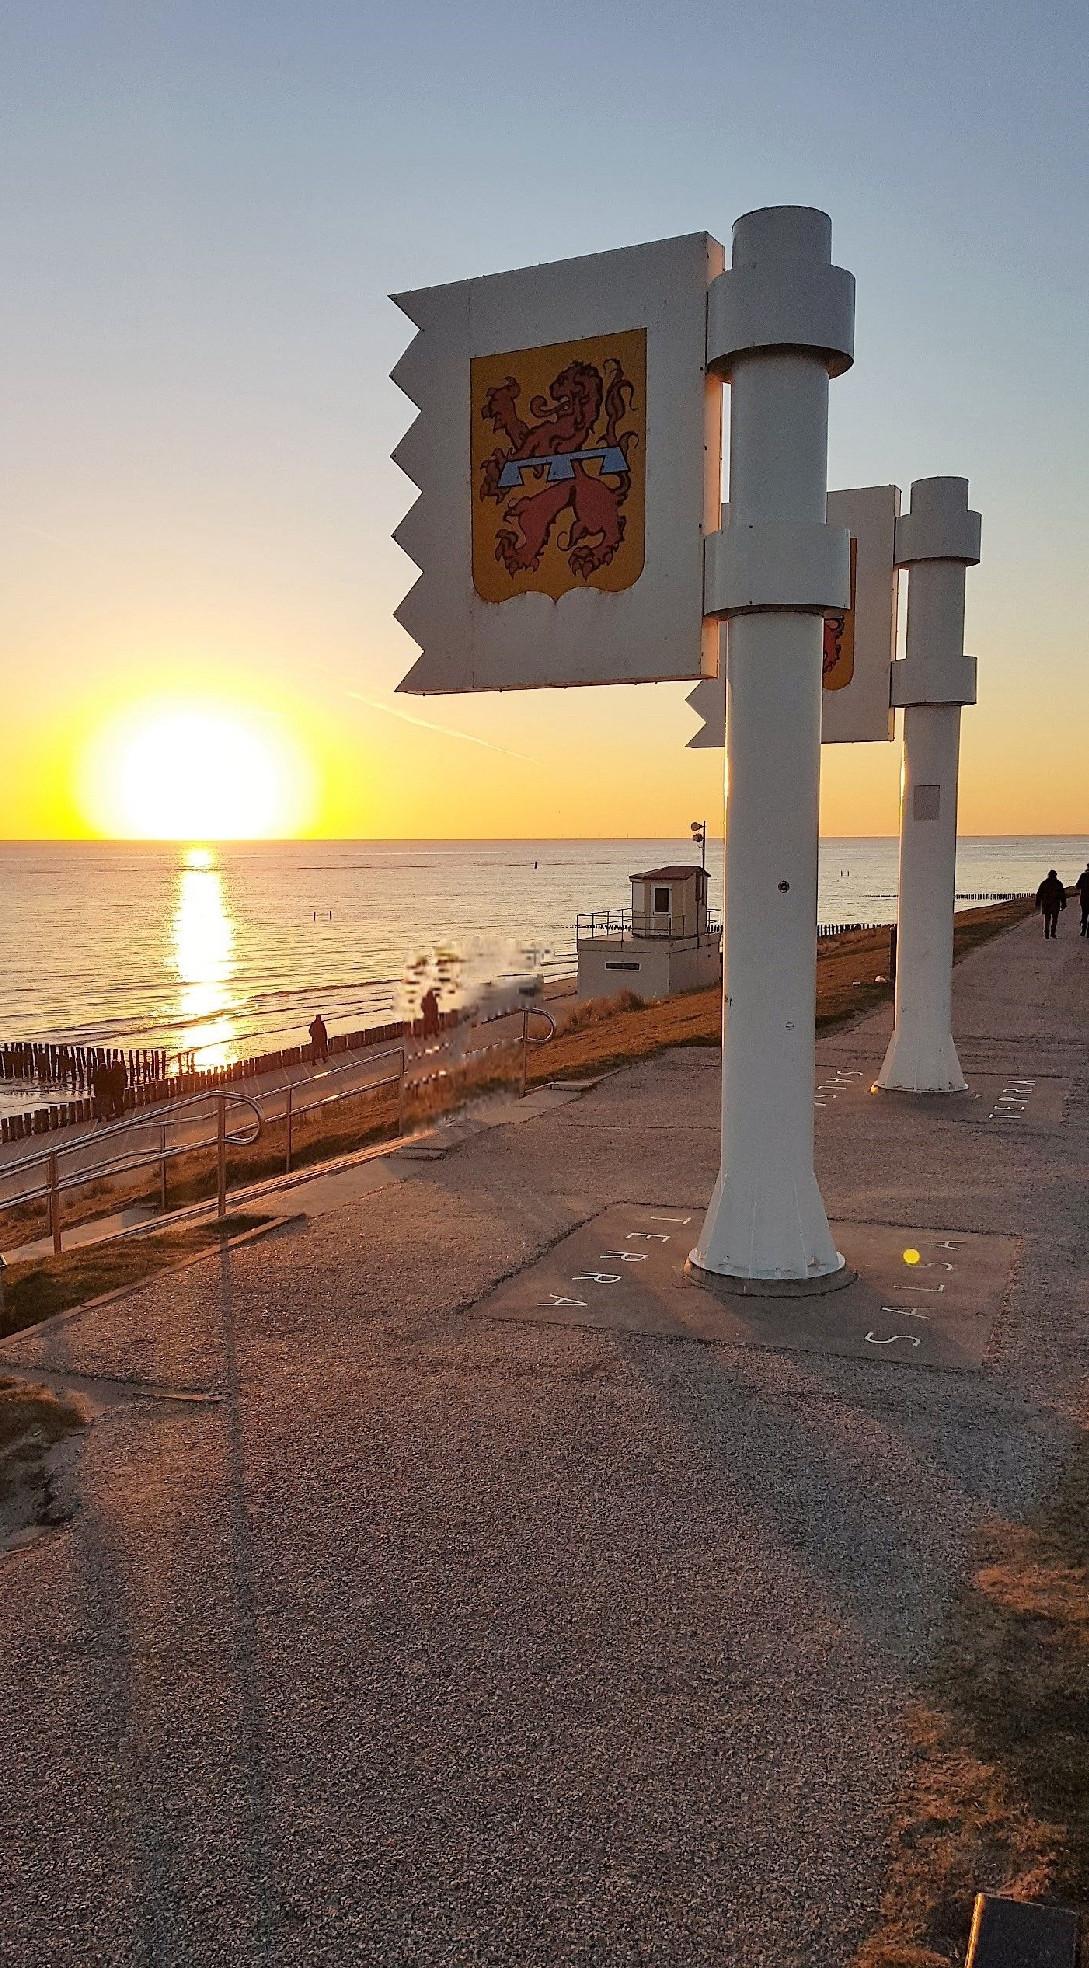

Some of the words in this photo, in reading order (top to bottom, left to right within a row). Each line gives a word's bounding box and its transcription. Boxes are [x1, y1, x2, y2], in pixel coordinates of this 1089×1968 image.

[988, 1080, 1036, 1119] TERRA
[536, 1216, 692, 1307] TERRA
[864, 1240, 968, 1347] SALSA
